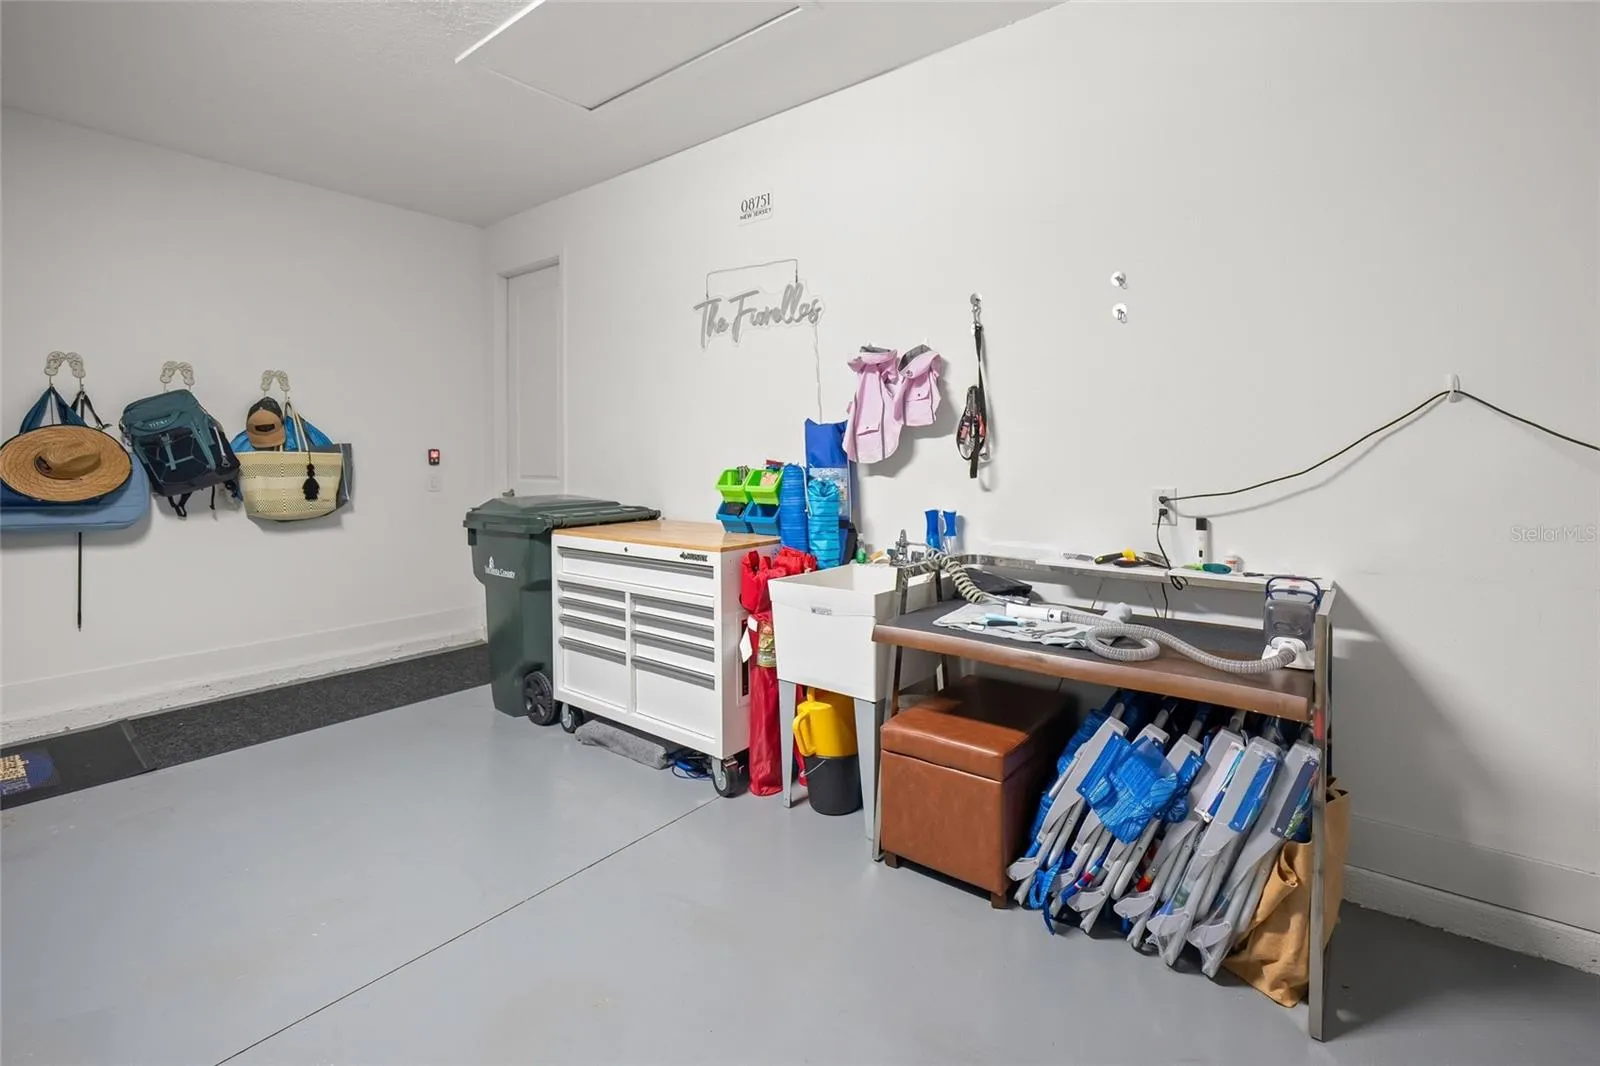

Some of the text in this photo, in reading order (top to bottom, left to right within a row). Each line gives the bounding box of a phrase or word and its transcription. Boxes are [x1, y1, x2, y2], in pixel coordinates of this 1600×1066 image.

[740, 192, 770, 213] 08751
[740, 207, 771, 220] NEW JERSEY
[693, 298, 730, 349] The
